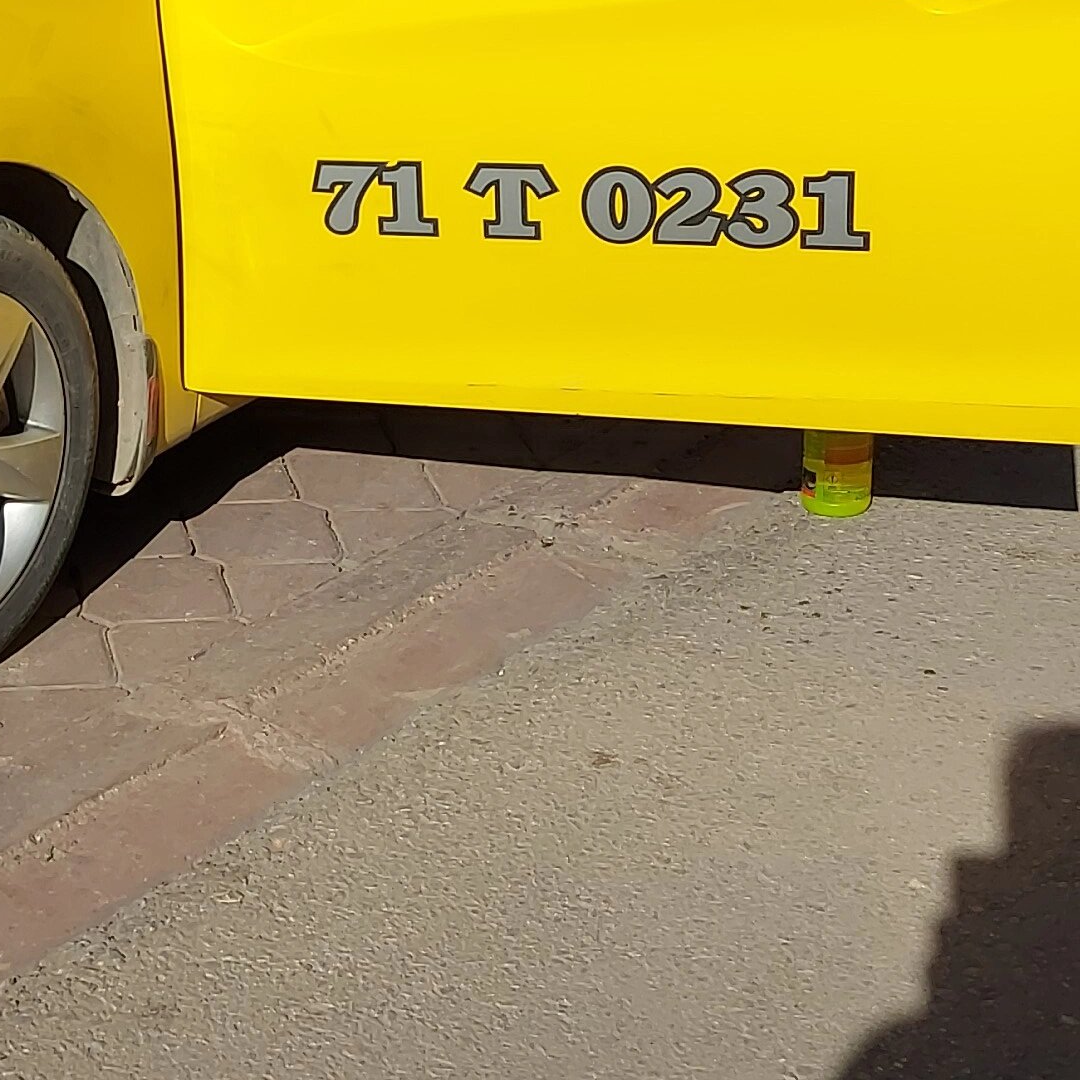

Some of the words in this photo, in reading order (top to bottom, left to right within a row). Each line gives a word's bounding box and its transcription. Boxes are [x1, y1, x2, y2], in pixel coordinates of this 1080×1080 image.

[311, 159, 439, 237] 71
[463, 162, 559, 240] T
[581, 166, 870, 251] 0231
